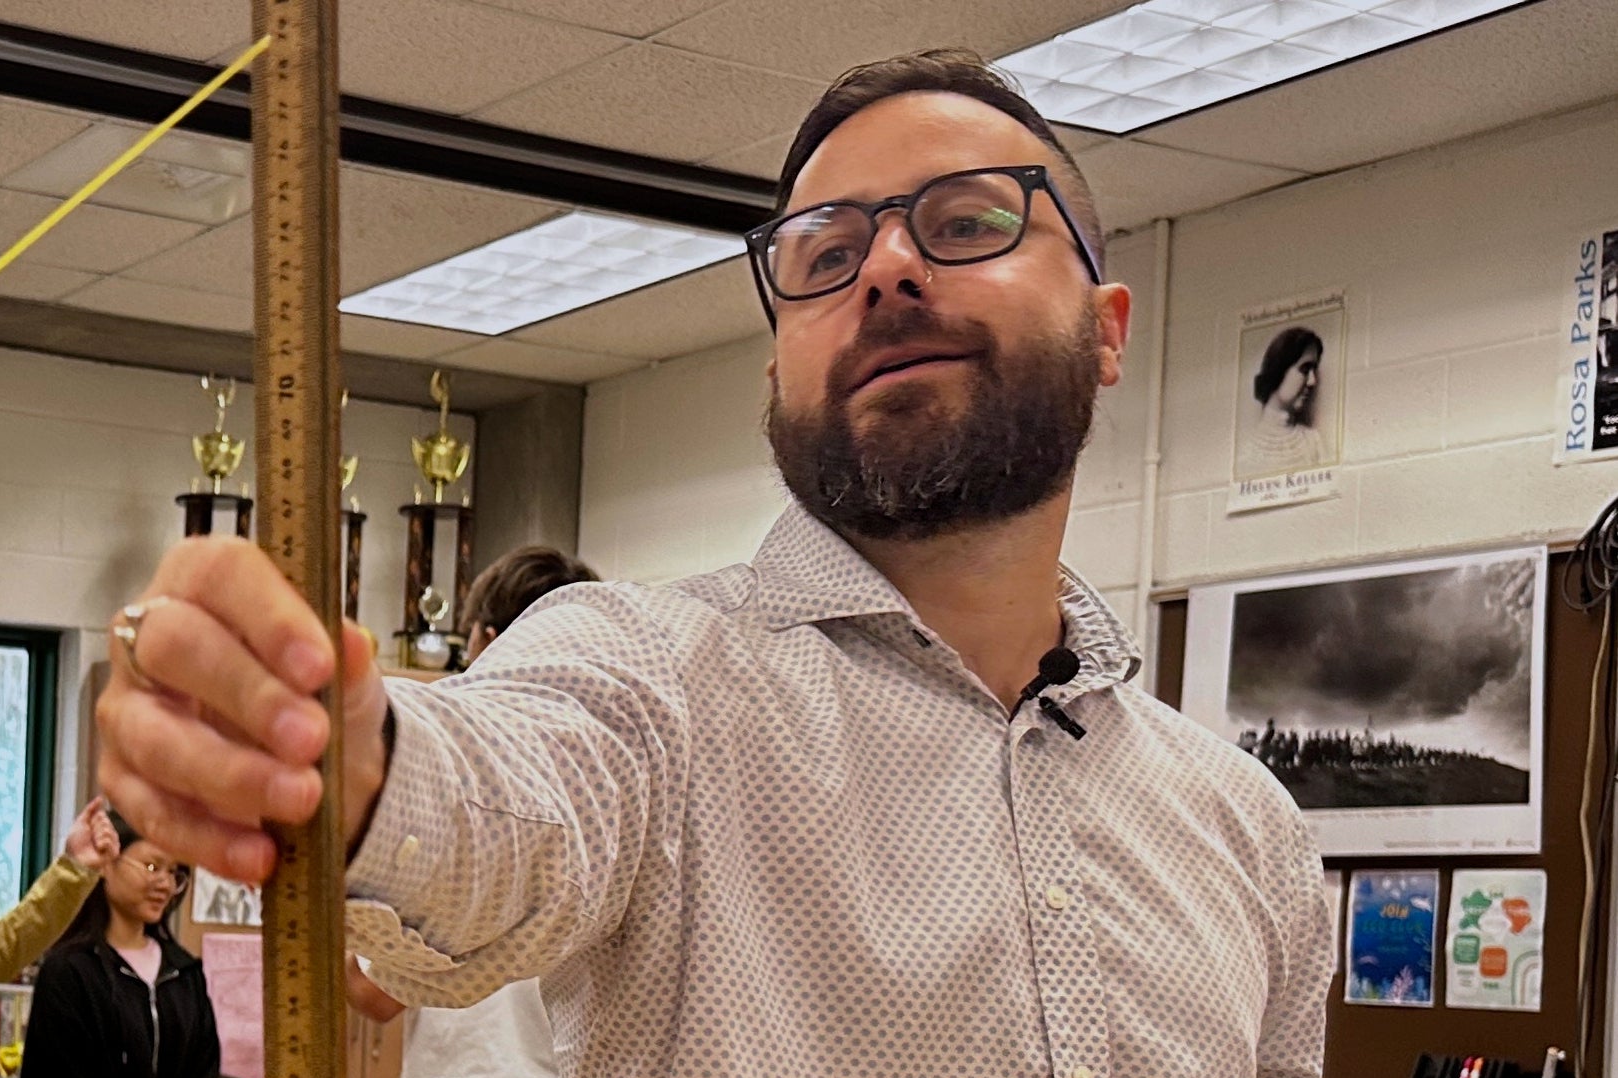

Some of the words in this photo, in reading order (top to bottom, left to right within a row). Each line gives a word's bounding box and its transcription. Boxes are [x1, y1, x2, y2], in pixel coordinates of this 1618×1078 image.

[1571, 239, 1597, 344] Parks
[278, 375, 294, 403] 70
[1566, 358, 1589, 450] Rosa
